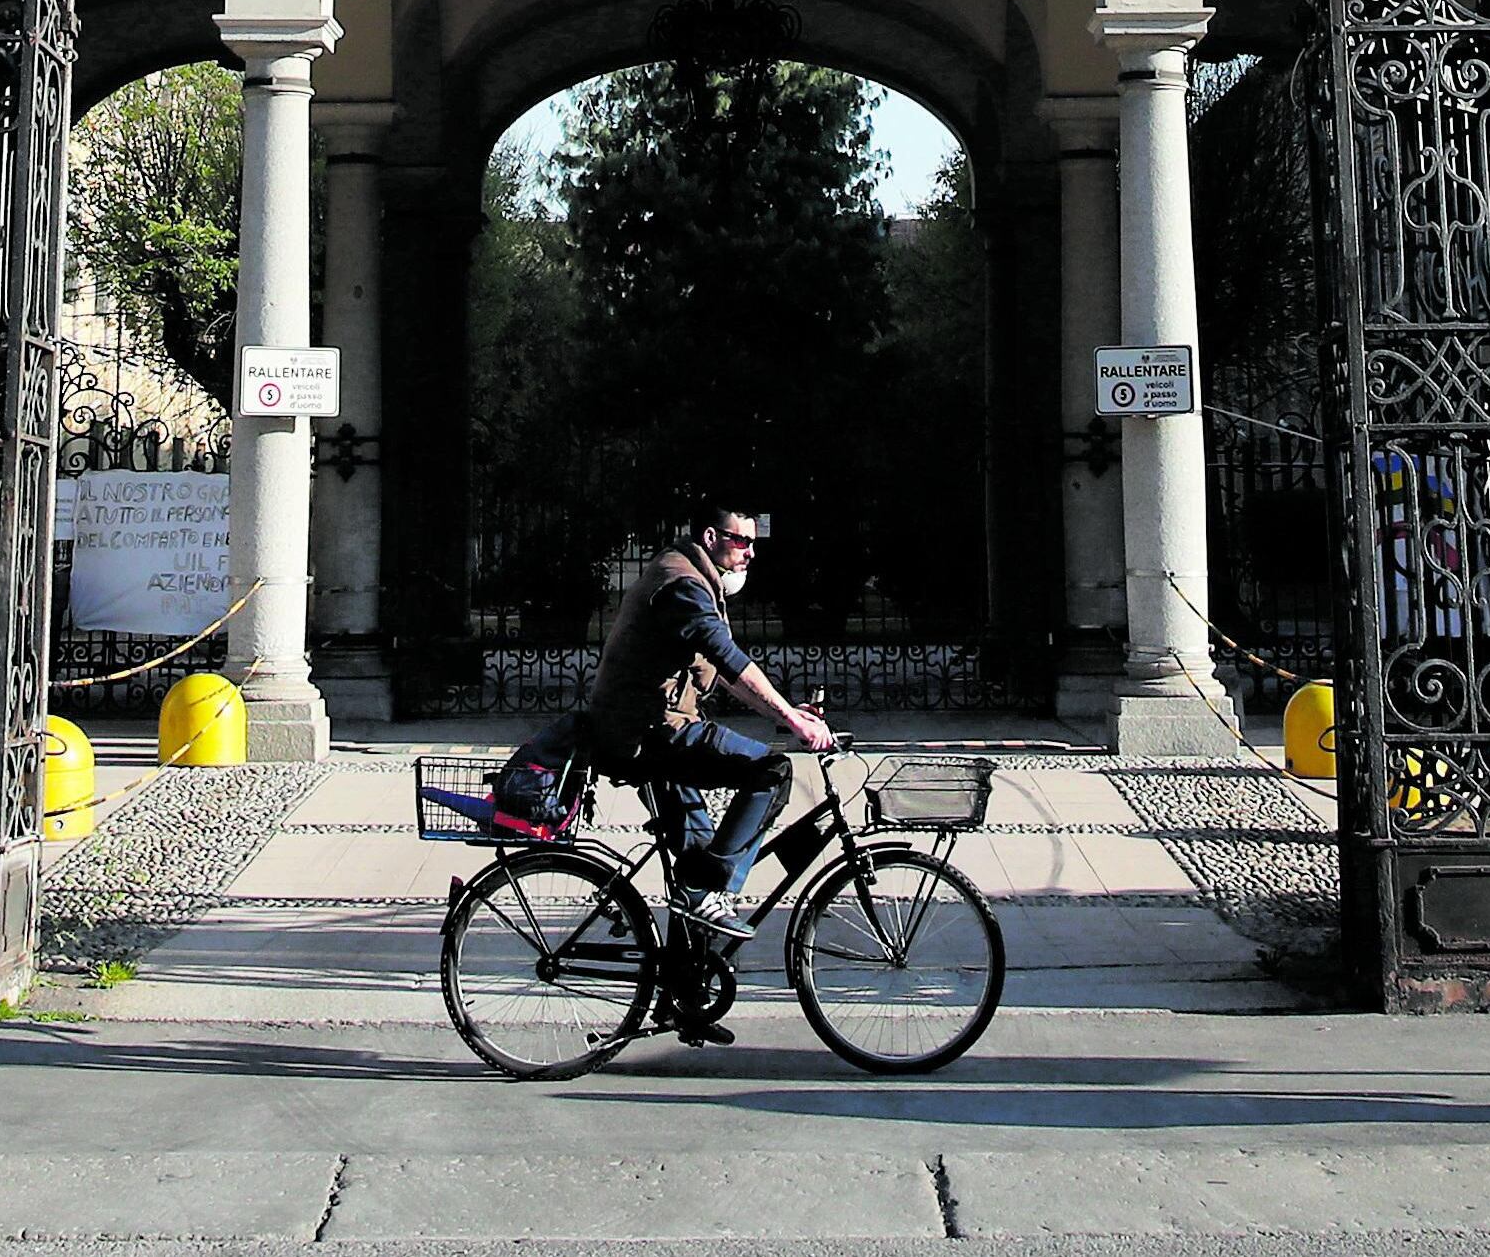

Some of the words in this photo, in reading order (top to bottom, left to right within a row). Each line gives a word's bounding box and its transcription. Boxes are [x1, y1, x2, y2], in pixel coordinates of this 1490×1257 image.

[249, 367, 332, 379] RALLENTARE
[1101, 365, 1186, 377] RALLENTARE
[1121, 389, 1127, 400] 5
[1151, 392, 1177, 400] passo
[103, 481, 192, 503] NOSTRO
[95, 505, 148, 525] TUTTO
[110, 528, 199, 550] COMPARTO
[174, 552, 209, 572] UIL
